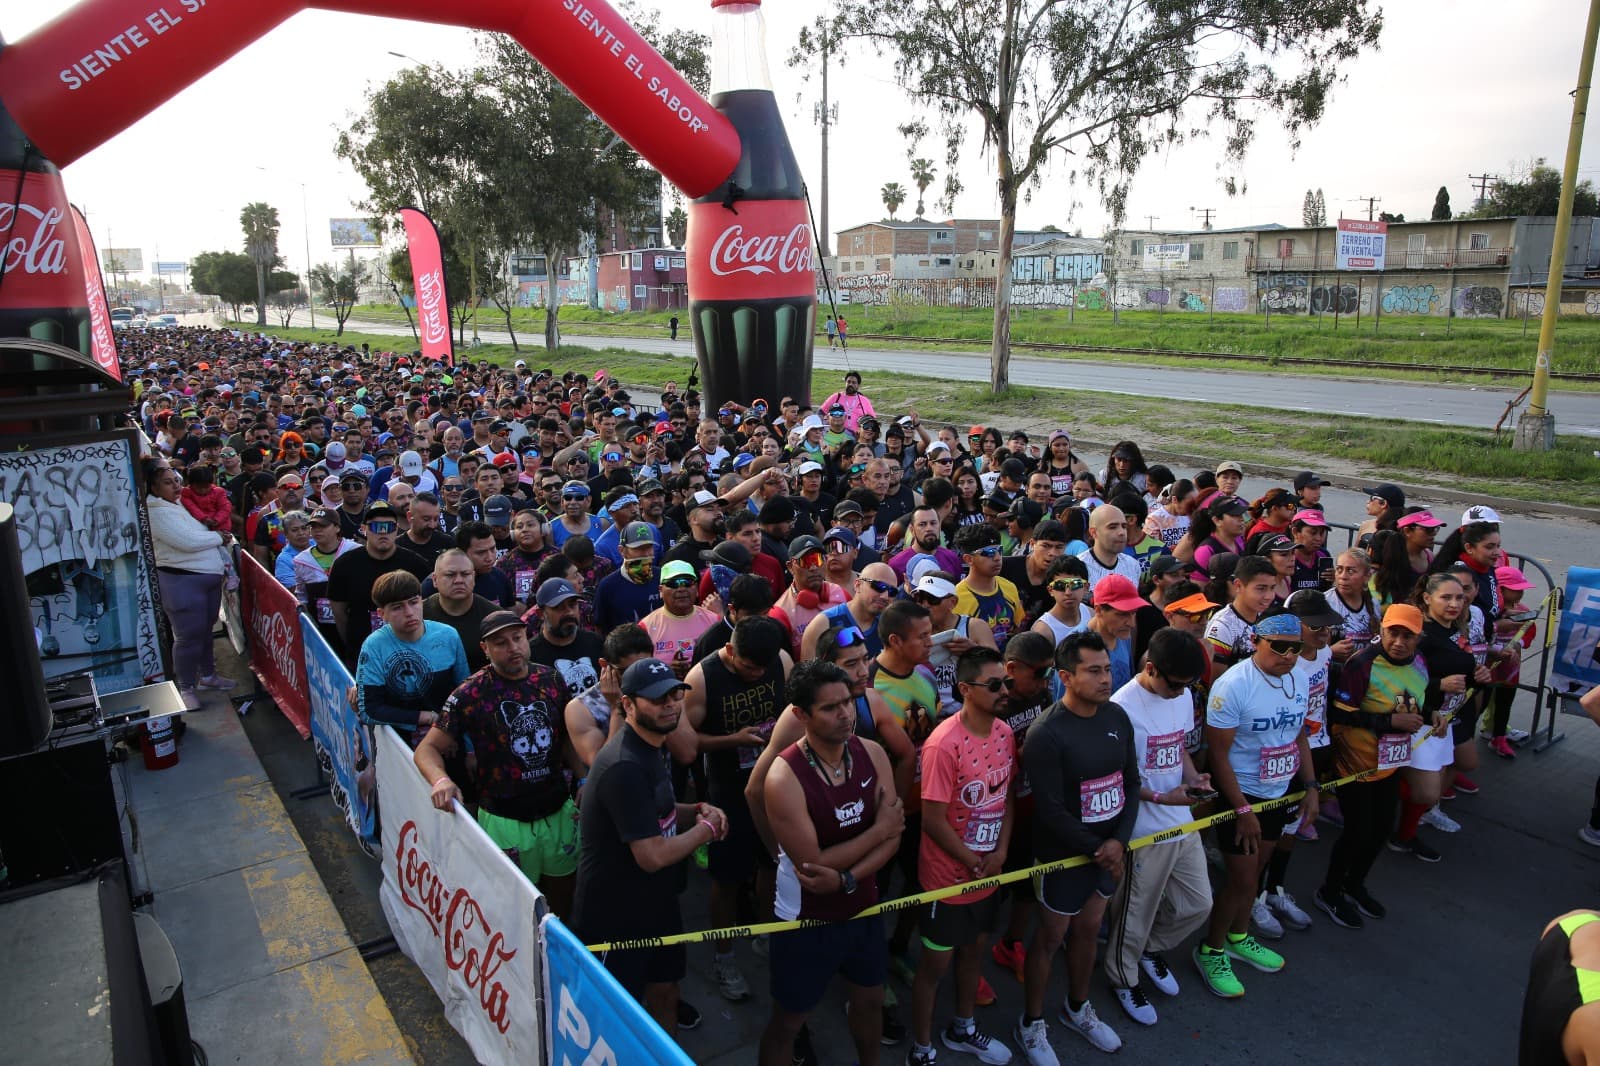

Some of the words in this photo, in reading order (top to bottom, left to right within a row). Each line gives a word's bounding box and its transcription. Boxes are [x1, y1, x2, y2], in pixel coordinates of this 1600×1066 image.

[59, 24, 149, 90] SIENTE
[145, 6, 182, 35] EL
[563, 0, 625, 58] SIENTE
[624, 53, 643, 80] EL
[1341, 245, 1350, 255] EN
[1351, 246, 1372, 257] VENTA
[1342, 235, 1371, 246] TERRENO
[722, 680, 776, 712] HAPPY
[723, 700, 776, 729] HOUR
[1156, 744, 1180, 766] 831
[1267, 755, 1295, 776] 983
[1387, 743, 1408, 762] 128
[1090, 787, 1120, 813] 409
[395, 820, 518, 1035] Coca-Cola
